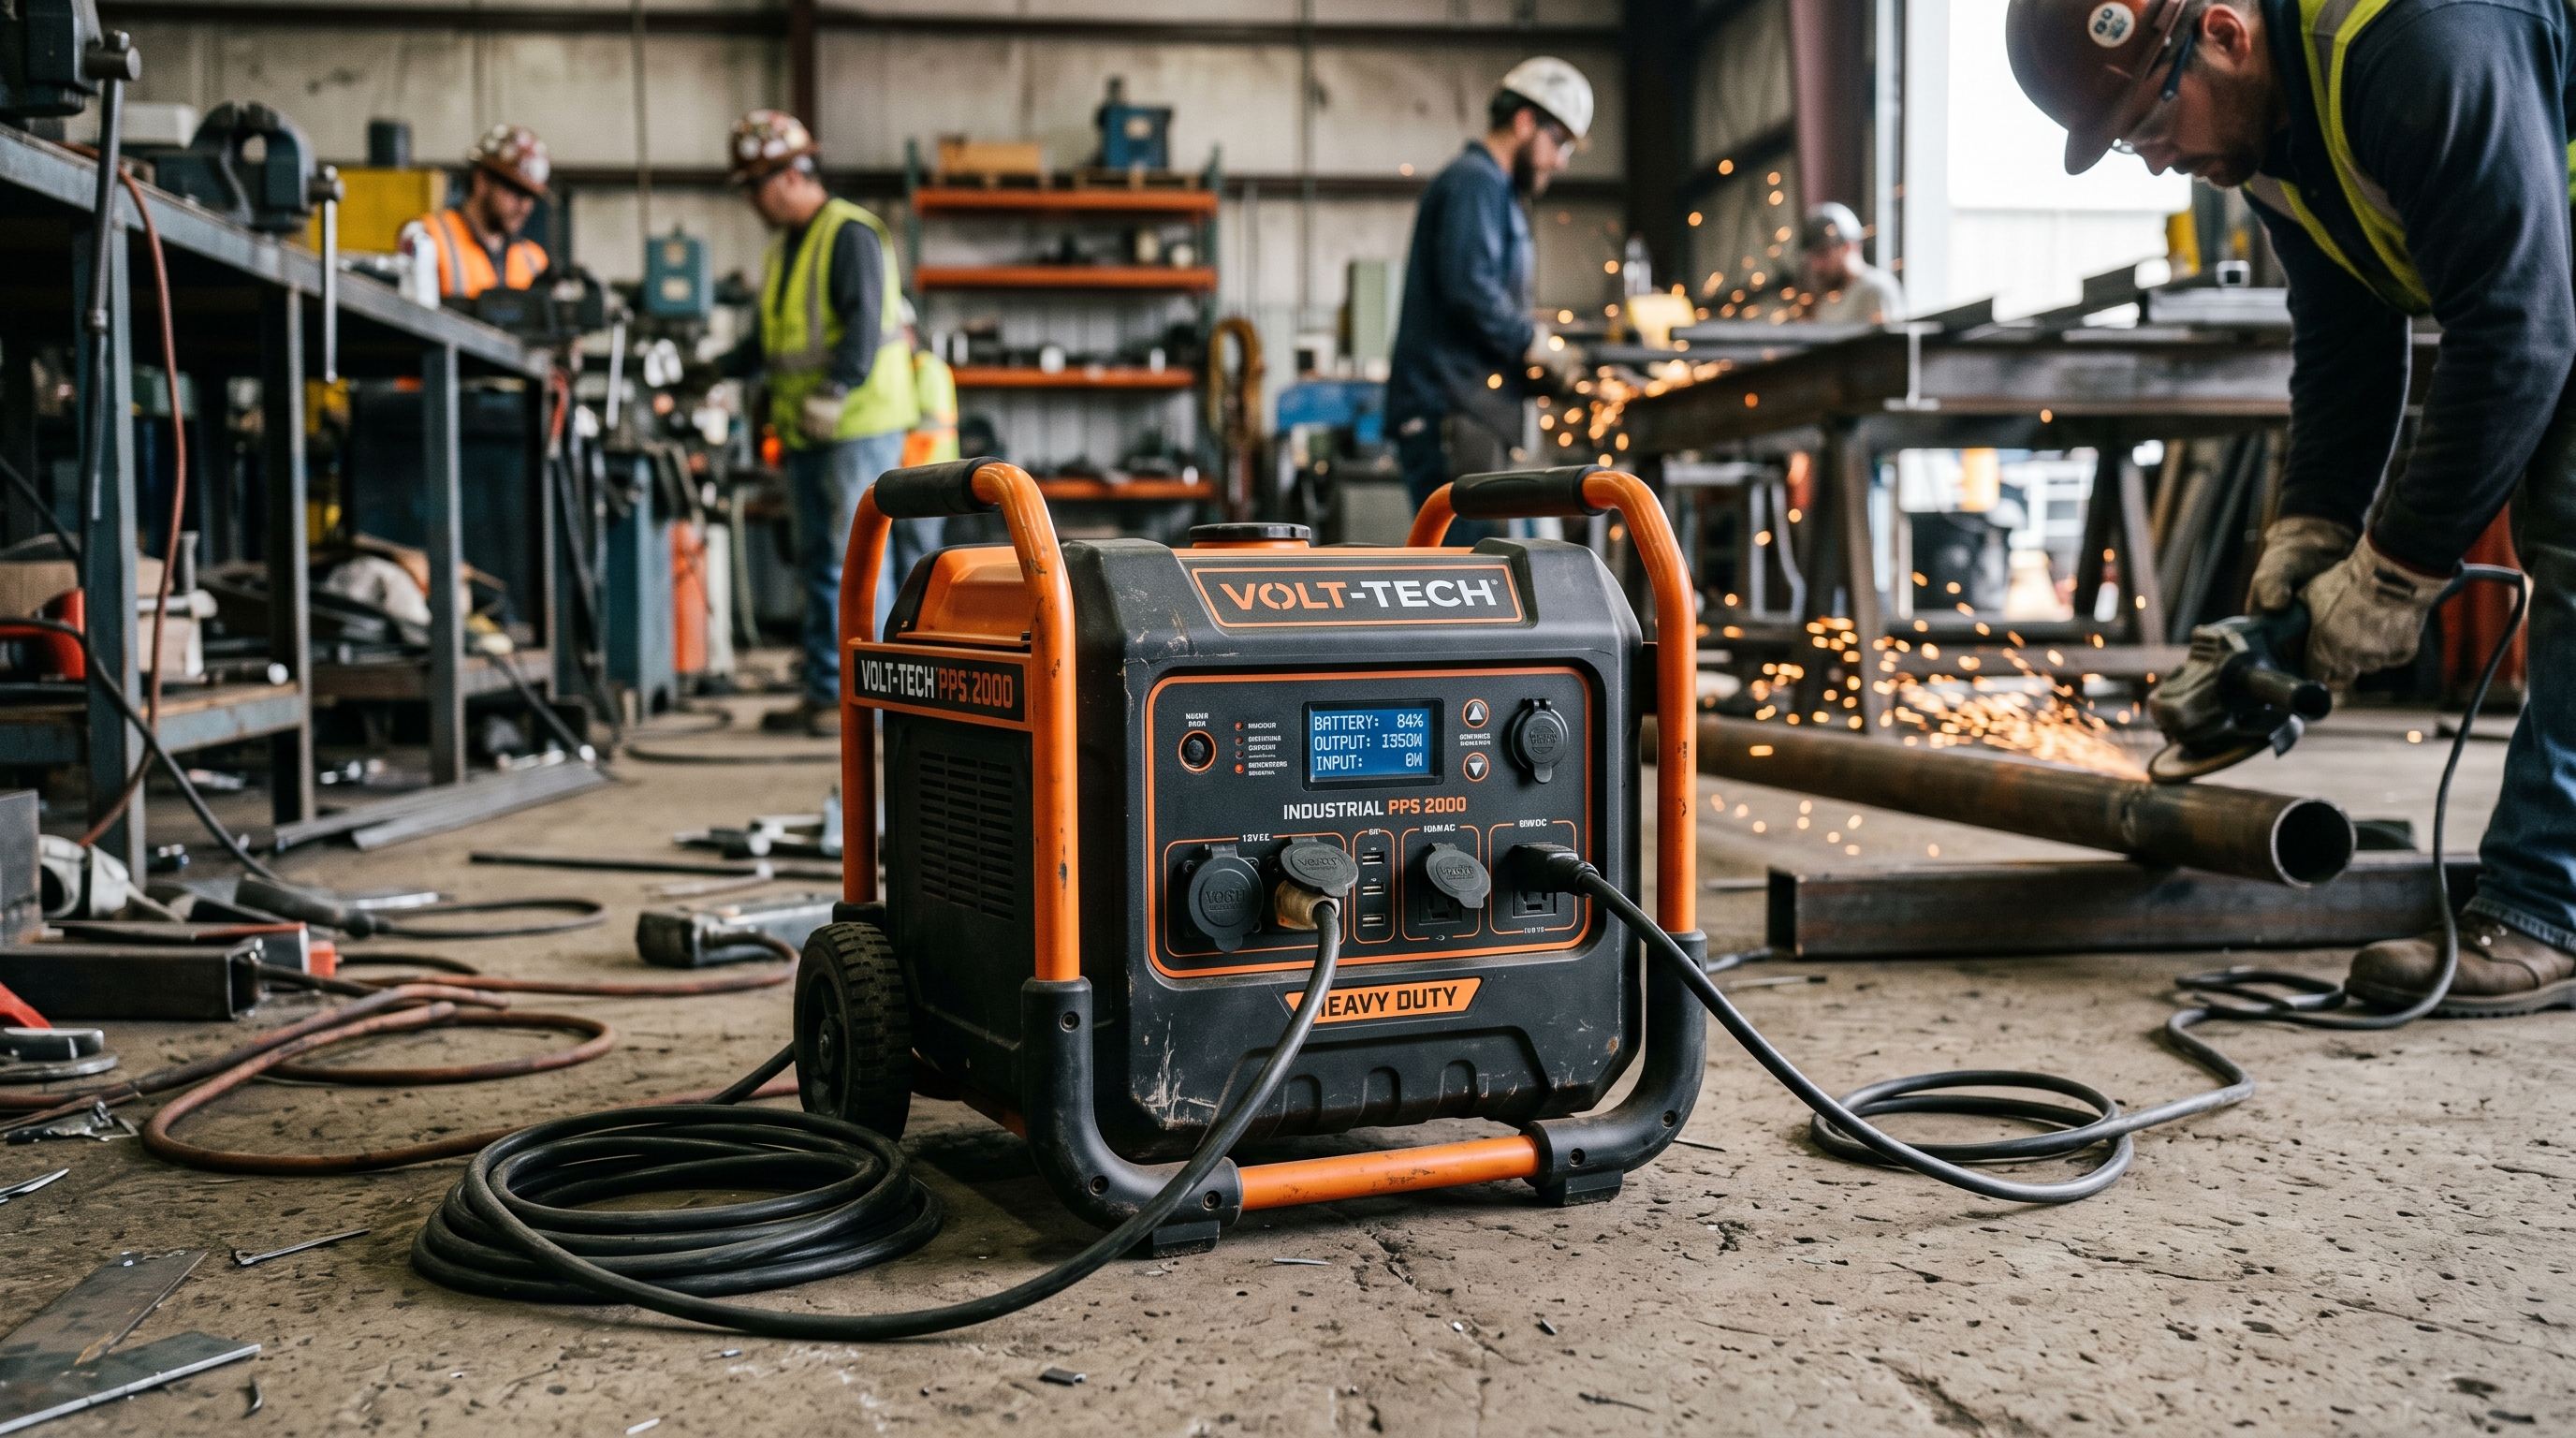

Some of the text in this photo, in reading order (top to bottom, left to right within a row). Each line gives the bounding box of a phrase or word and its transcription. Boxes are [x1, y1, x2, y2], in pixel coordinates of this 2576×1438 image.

[939, 668, 968, 703] PPS
[972, 671, 1014, 710] 2000
[1314, 713, 1424, 731] BATTERY: 84%
[1314, 734, 1371, 752] OUTPUT:
[1316, 755, 1363, 771] INPUT:
[1283, 796, 1467, 820] INDUSTRIAL PPS 2000
[1397, 986, 1458, 1011] DUTY
